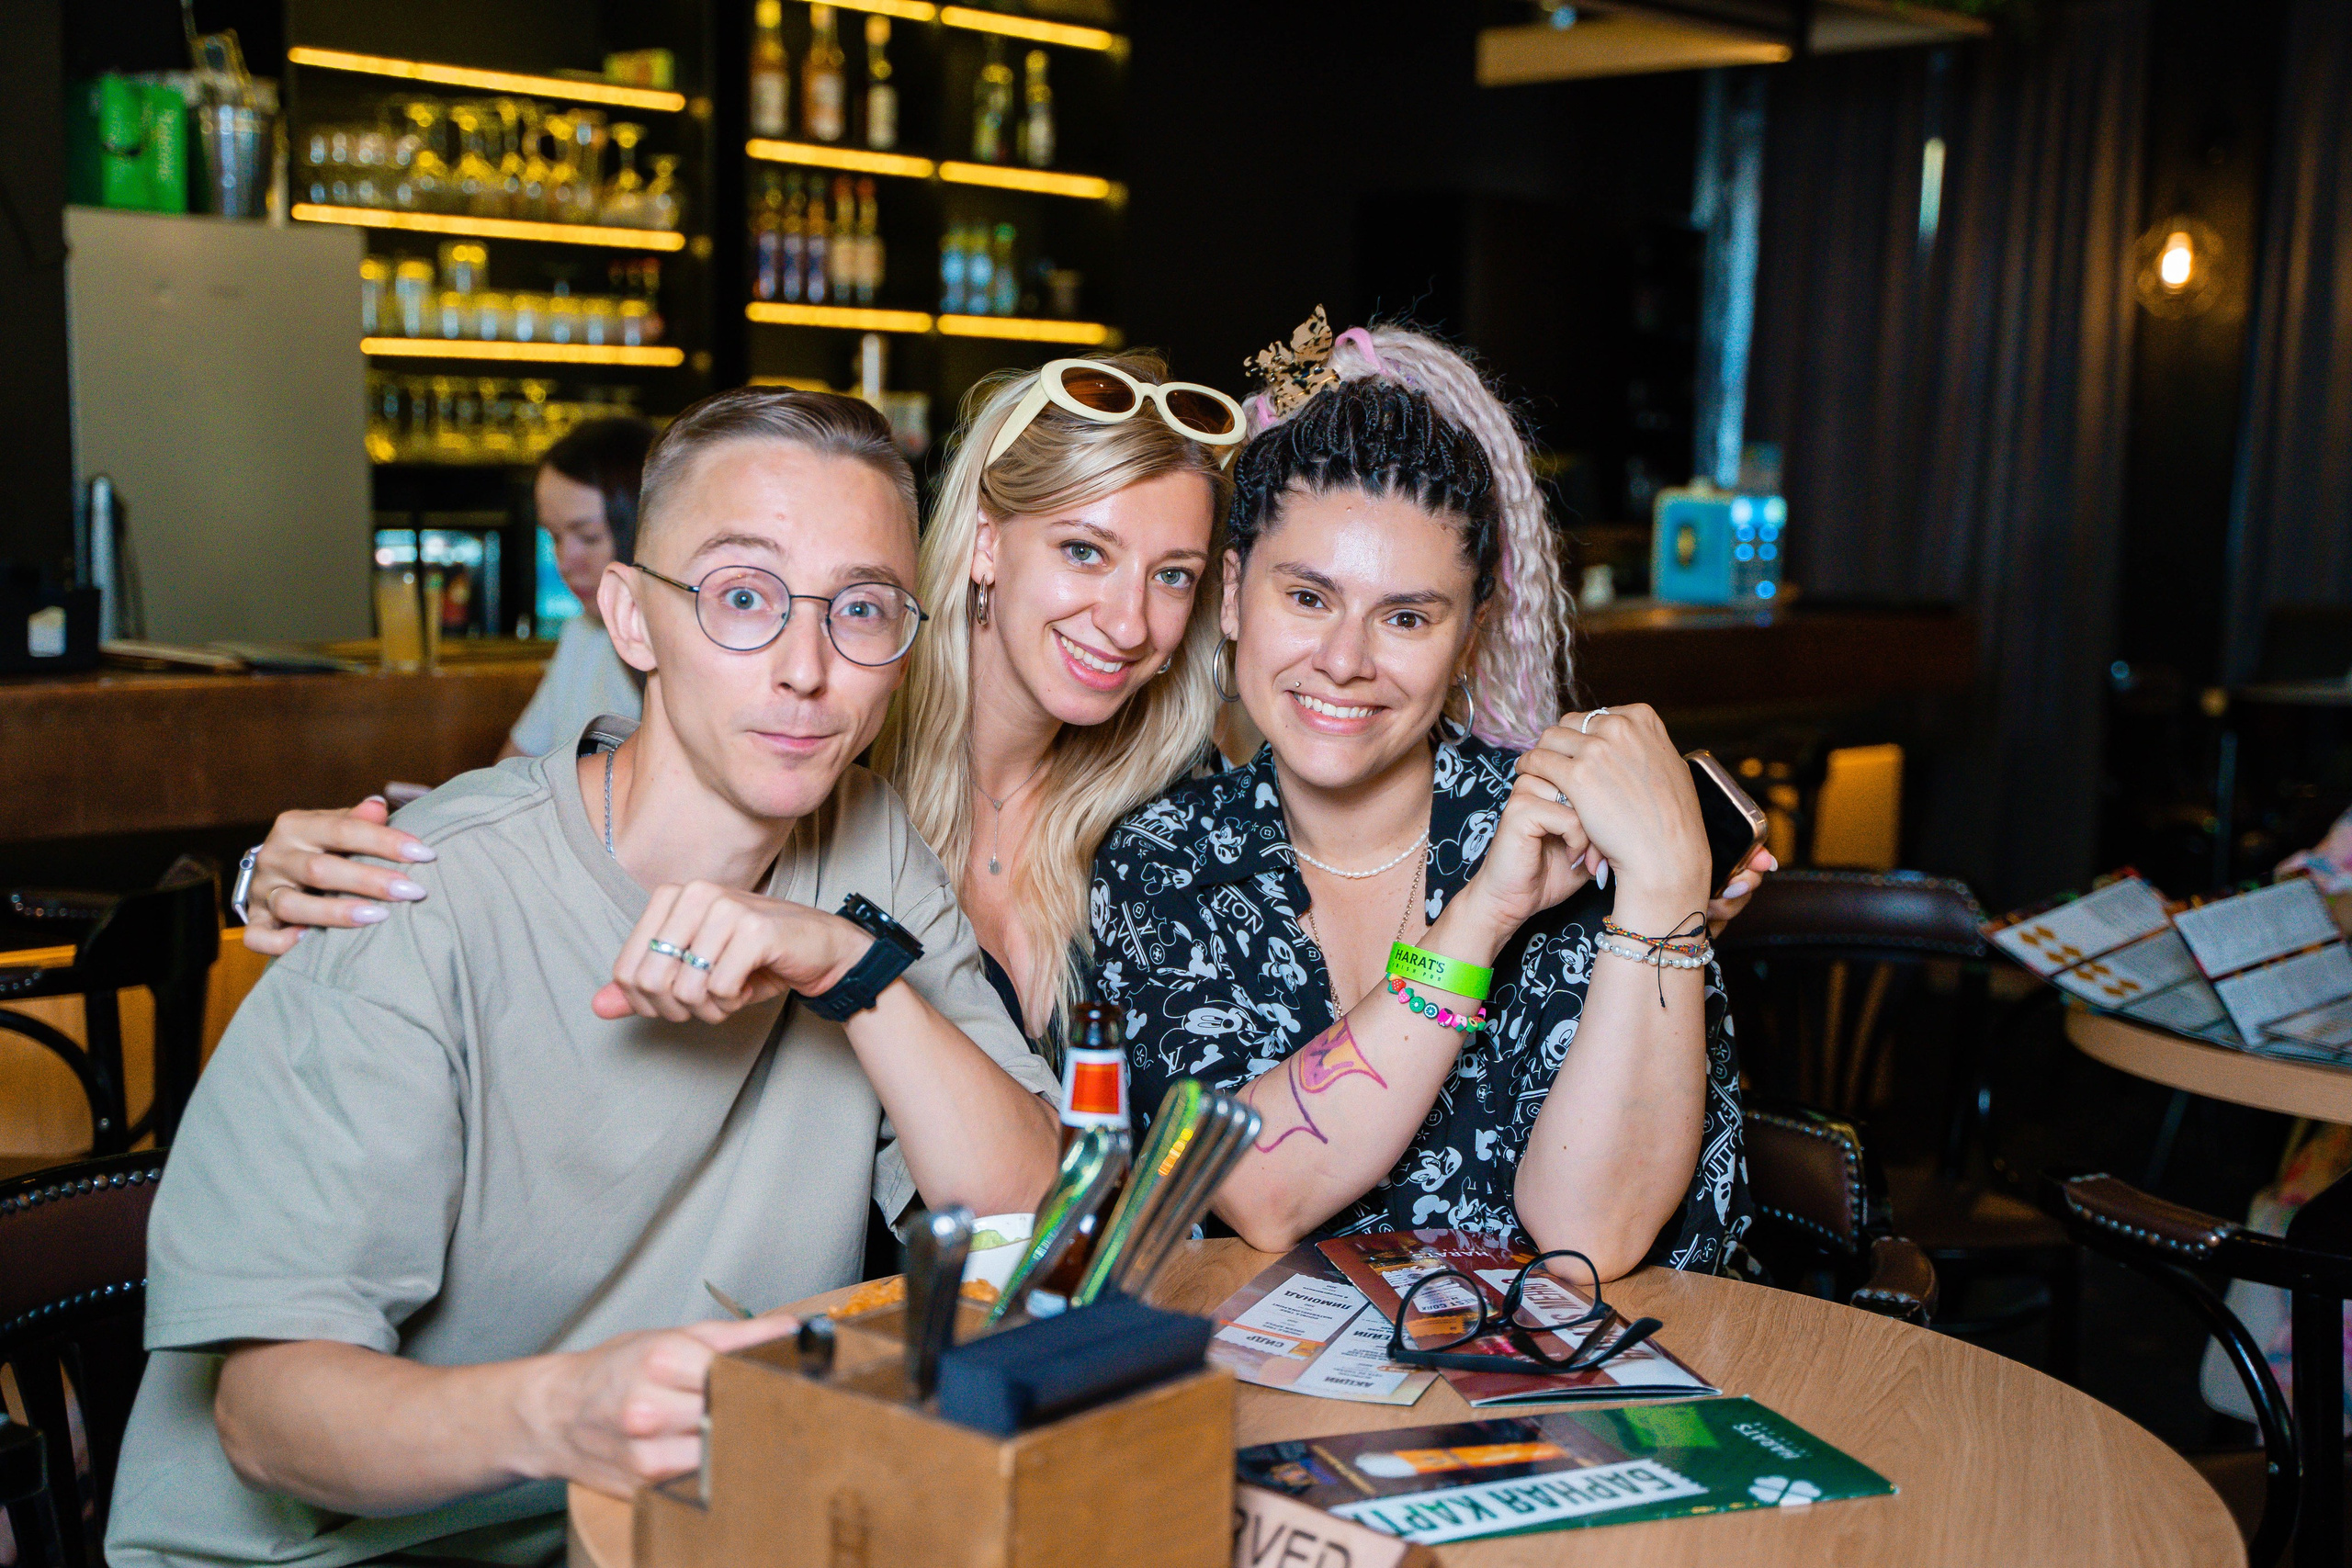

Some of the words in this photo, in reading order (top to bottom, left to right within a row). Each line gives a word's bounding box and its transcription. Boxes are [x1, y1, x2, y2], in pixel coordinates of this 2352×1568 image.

[1395, 949, 1445, 974] HARAT'S
[1283, 1290, 1352, 1311] ЛИМОНАД
[1420, 1303, 1447, 1311] CORK
[1246, 1335, 1285, 1348] СИДР
[1323, 1376, 1374, 1389] АКЦИИ
[1488, 1468, 1677, 1515] БАРНАЯ
